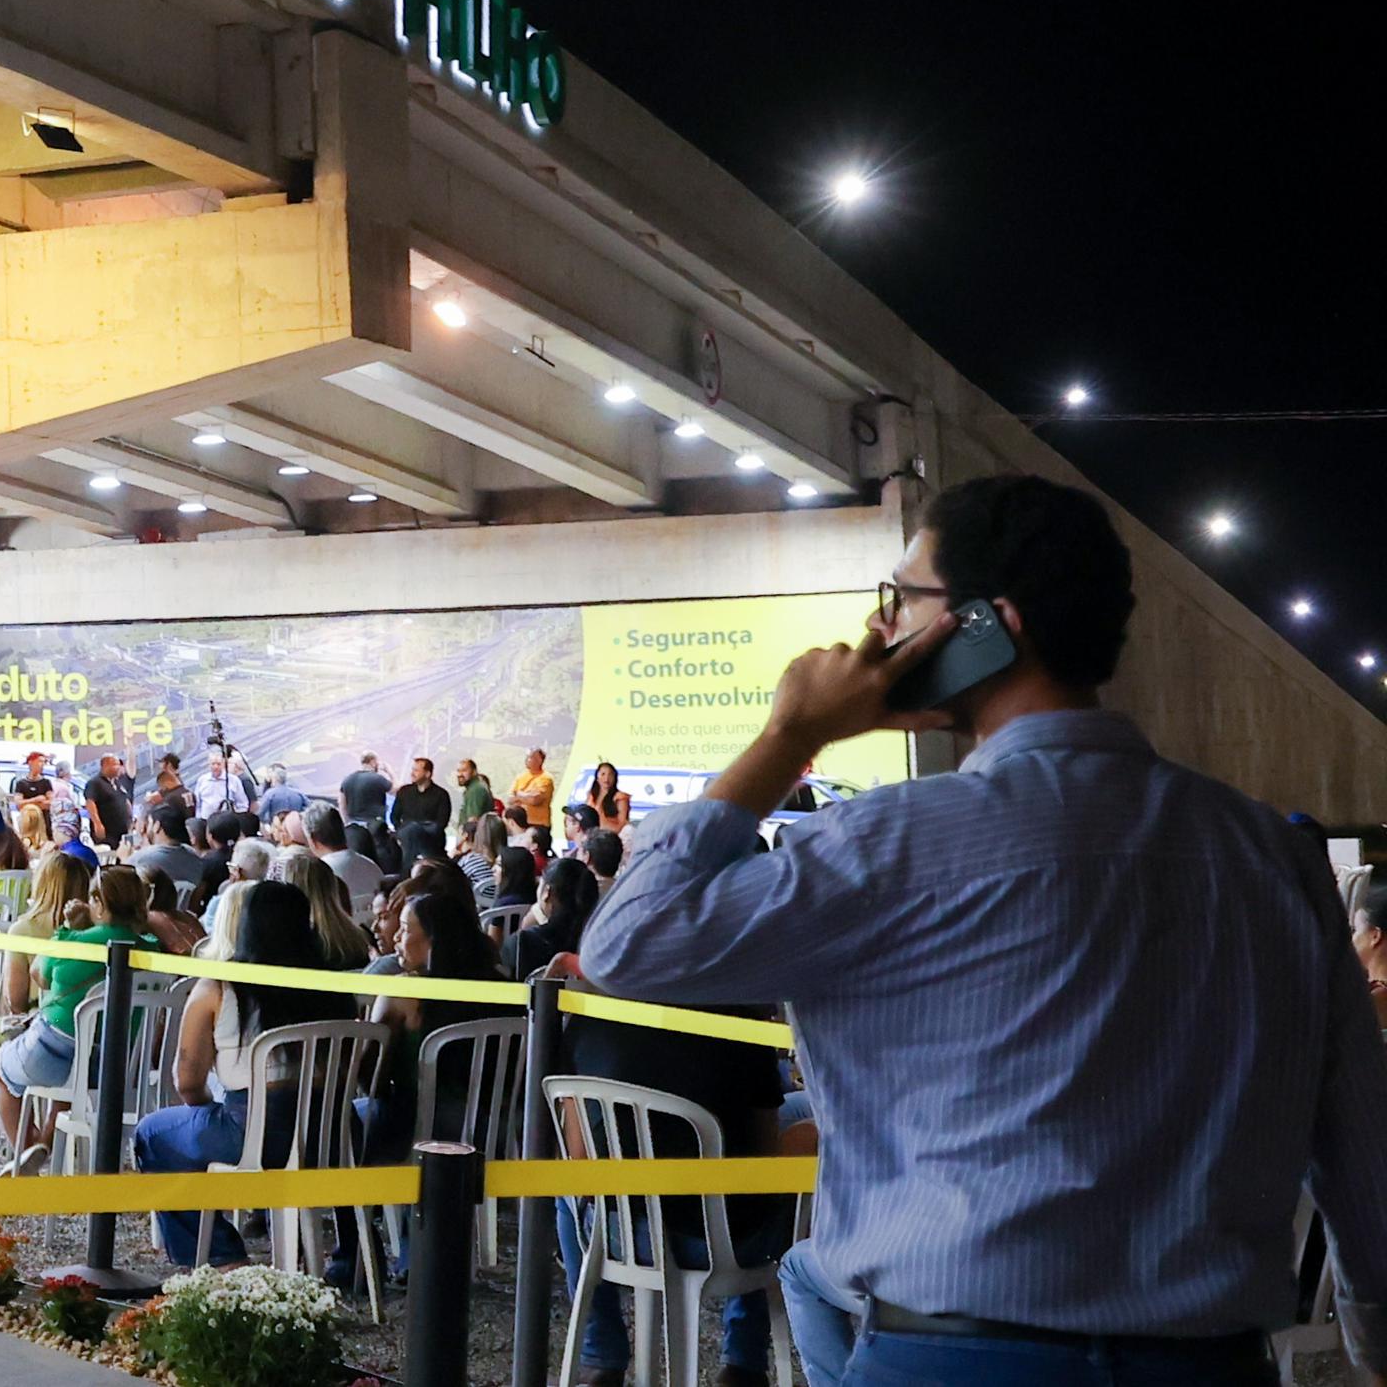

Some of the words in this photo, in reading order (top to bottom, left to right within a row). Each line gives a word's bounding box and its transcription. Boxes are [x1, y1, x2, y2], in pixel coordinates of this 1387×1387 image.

[627, 629, 753, 652] Segurança
[628, 658, 734, 678] Conforto
[61, 708, 114, 746] da
[123, 705, 173, 746] Fé
[630, 724, 666, 737] Mais
[669, 723, 689, 736] do
[693, 724, 721, 738] que
[726, 723, 760, 734] uma
[631, 742, 652, 755] elo
[657, 742, 697, 755] entre
